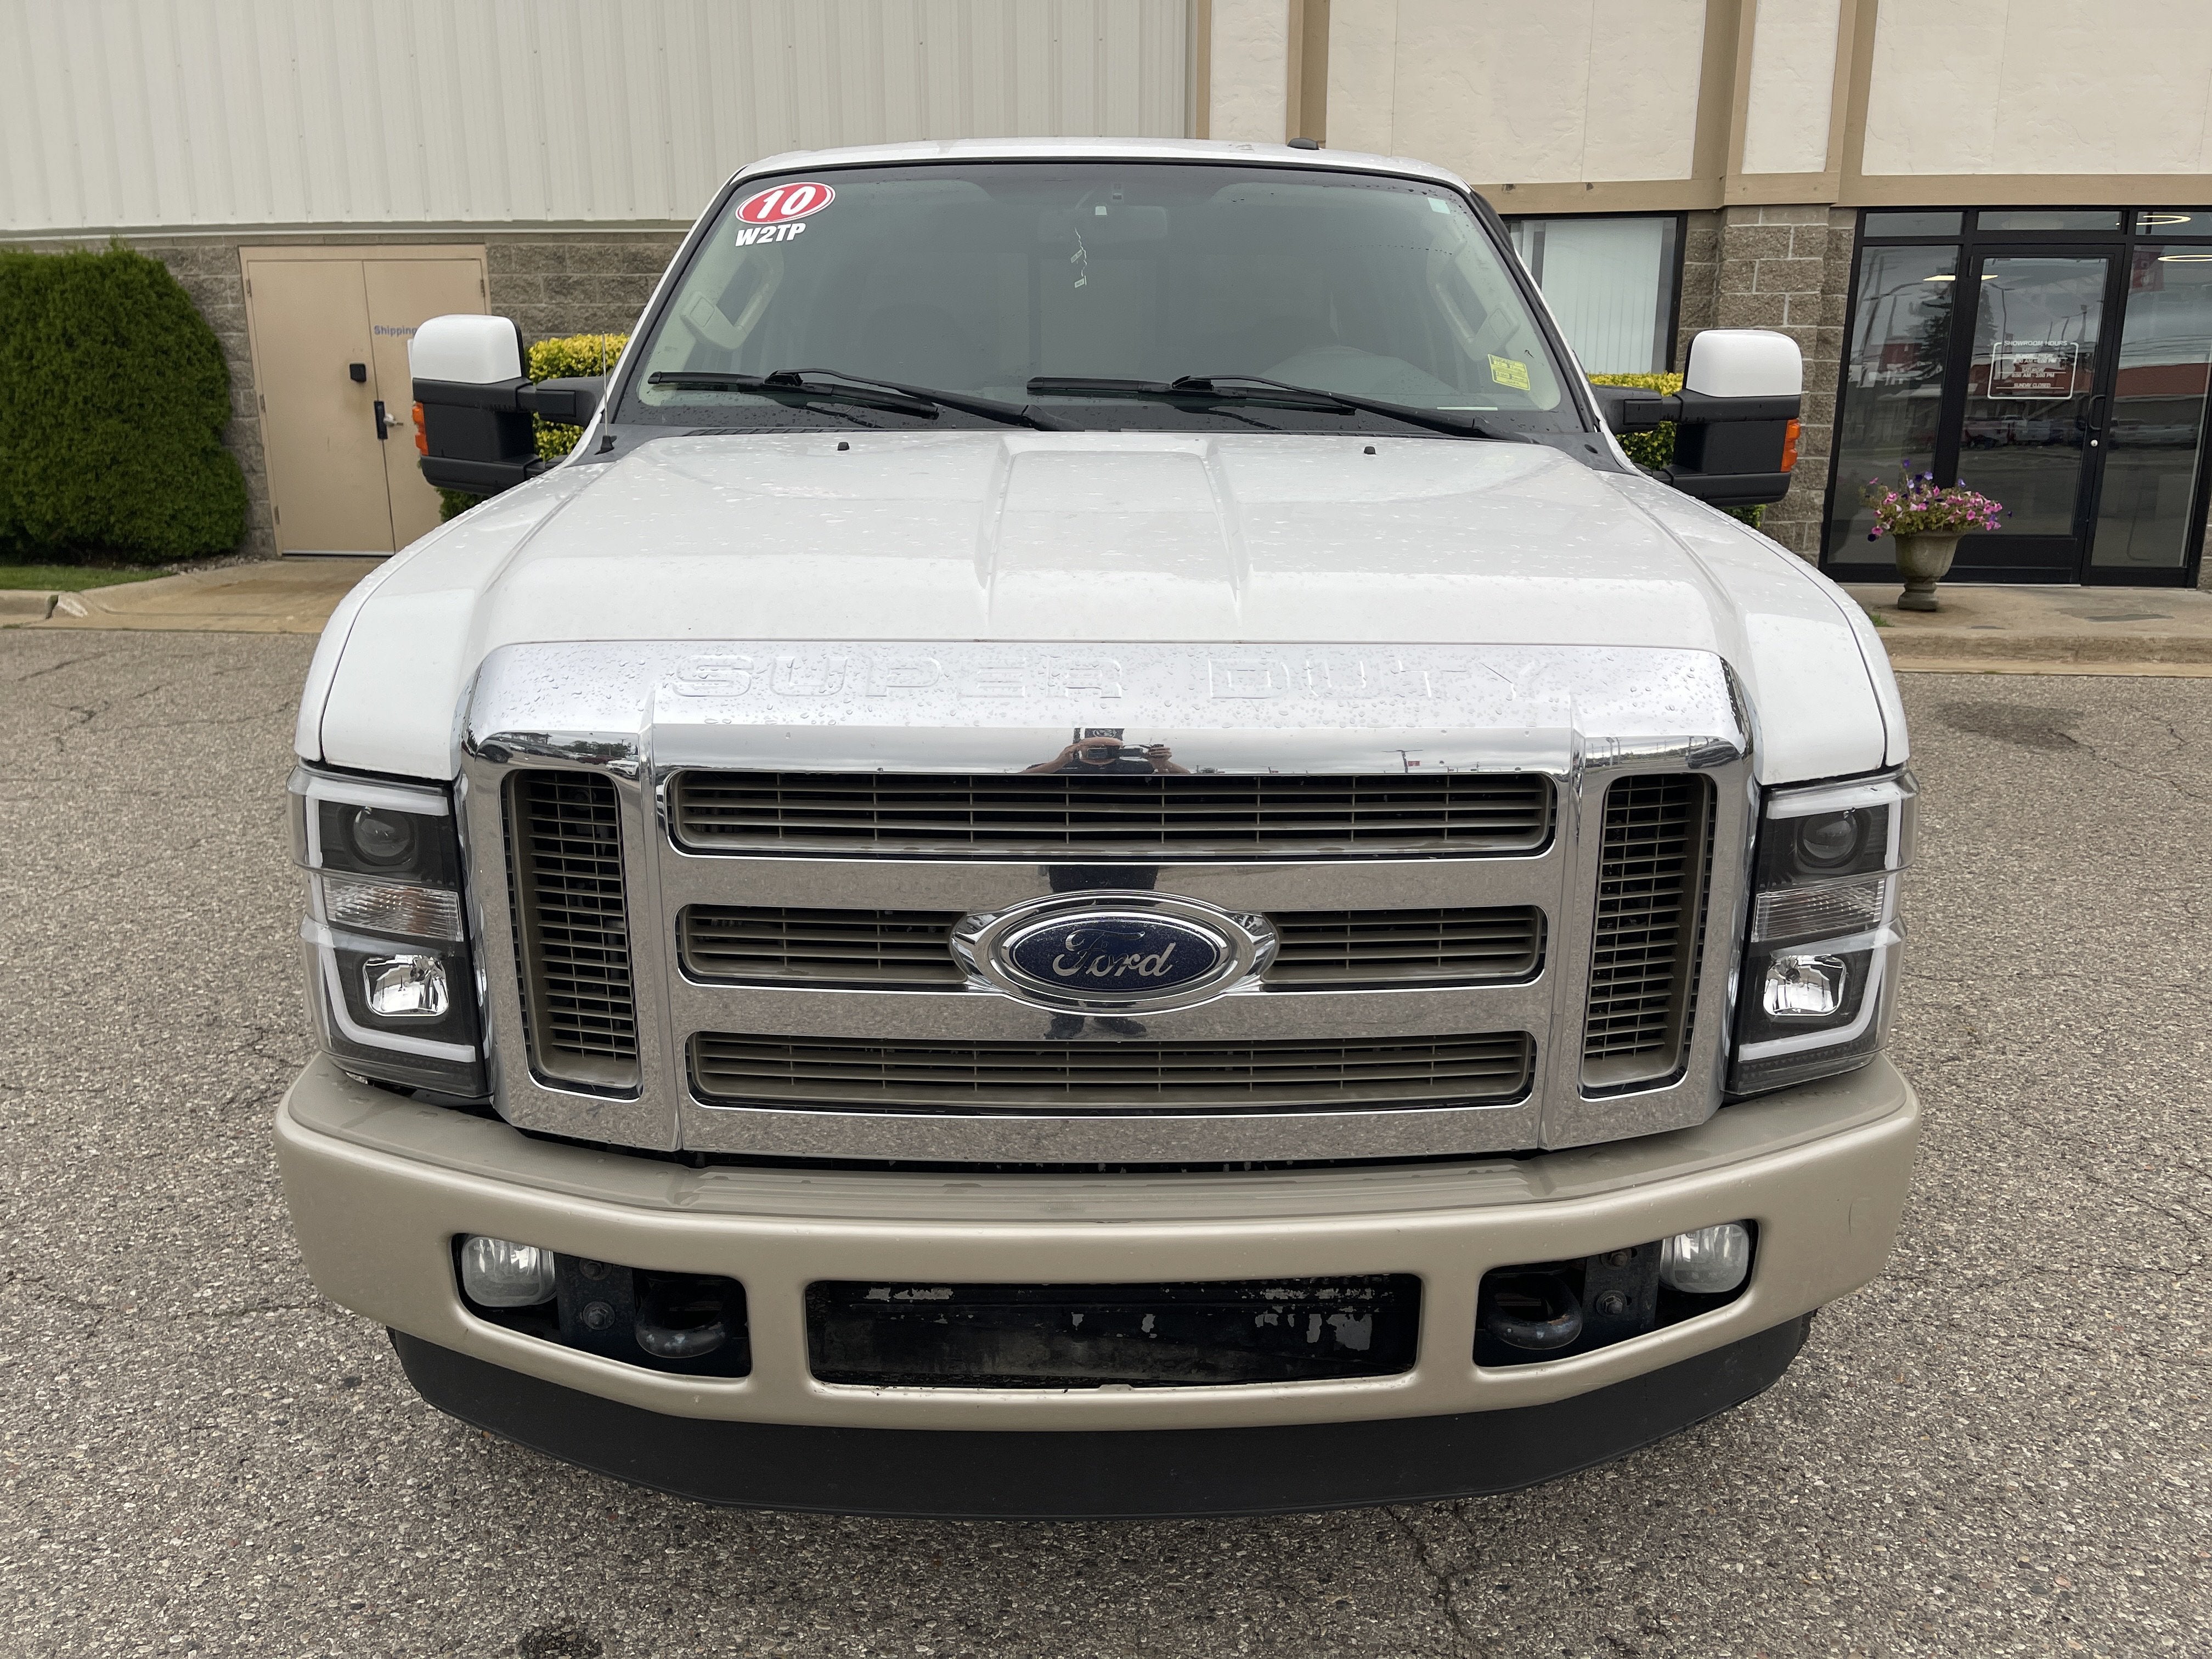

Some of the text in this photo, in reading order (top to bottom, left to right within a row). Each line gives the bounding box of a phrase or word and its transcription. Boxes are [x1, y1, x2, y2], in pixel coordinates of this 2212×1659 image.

[757, 185, 816, 219] 10
[735, 222, 806, 247] W2TP
[672, 654, 1549, 699] SUPER DUTY
[1052, 928, 1176, 977] Ford
